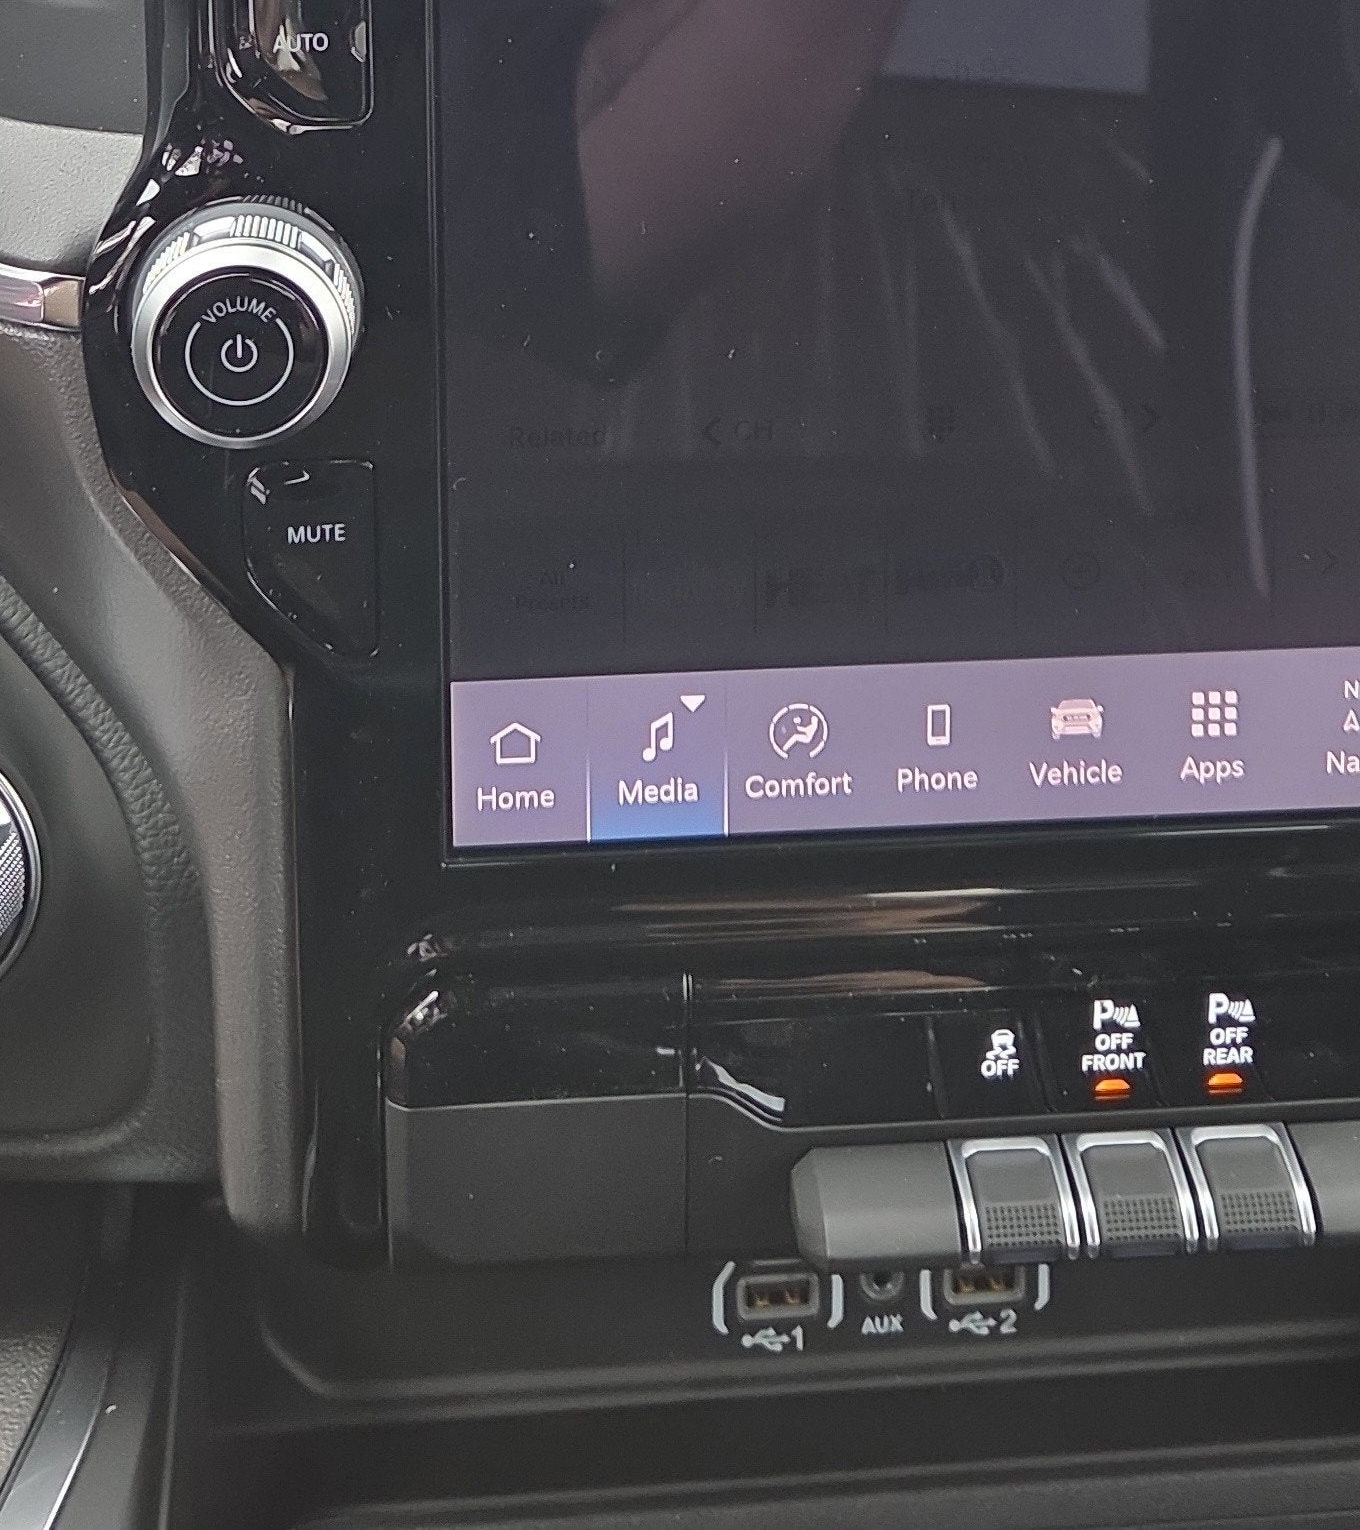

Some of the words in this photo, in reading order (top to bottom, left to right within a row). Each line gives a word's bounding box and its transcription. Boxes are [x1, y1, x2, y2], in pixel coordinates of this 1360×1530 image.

[272, 31, 329, 53] AUTO
[202, 296, 277, 324] VOLUME
[287, 523, 346, 545] MUTE
[1343, 680, 1359, 698] N
[897, 767, 978, 793] Phone
[1029, 758, 1123, 788] Vehicle
[1180, 756, 1244, 785] Apps
[618, 778, 699, 805] Media
[744, 771, 853, 800] Comfort
[476, 787, 555, 812] Home
[1095, 1033, 1134, 1052] OFF
[1209, 1027, 1248, 1045] OFF
[1081, 1051, 1146, 1072] FRONT
[1203, 1046, 1253, 1066] REAR
[981, 1058, 1020, 1079] OFF
[861, 1314, 905, 1335] AUX
[999, 1308, 1018, 1334] 2
[792, 1324, 804, 1352] 1
